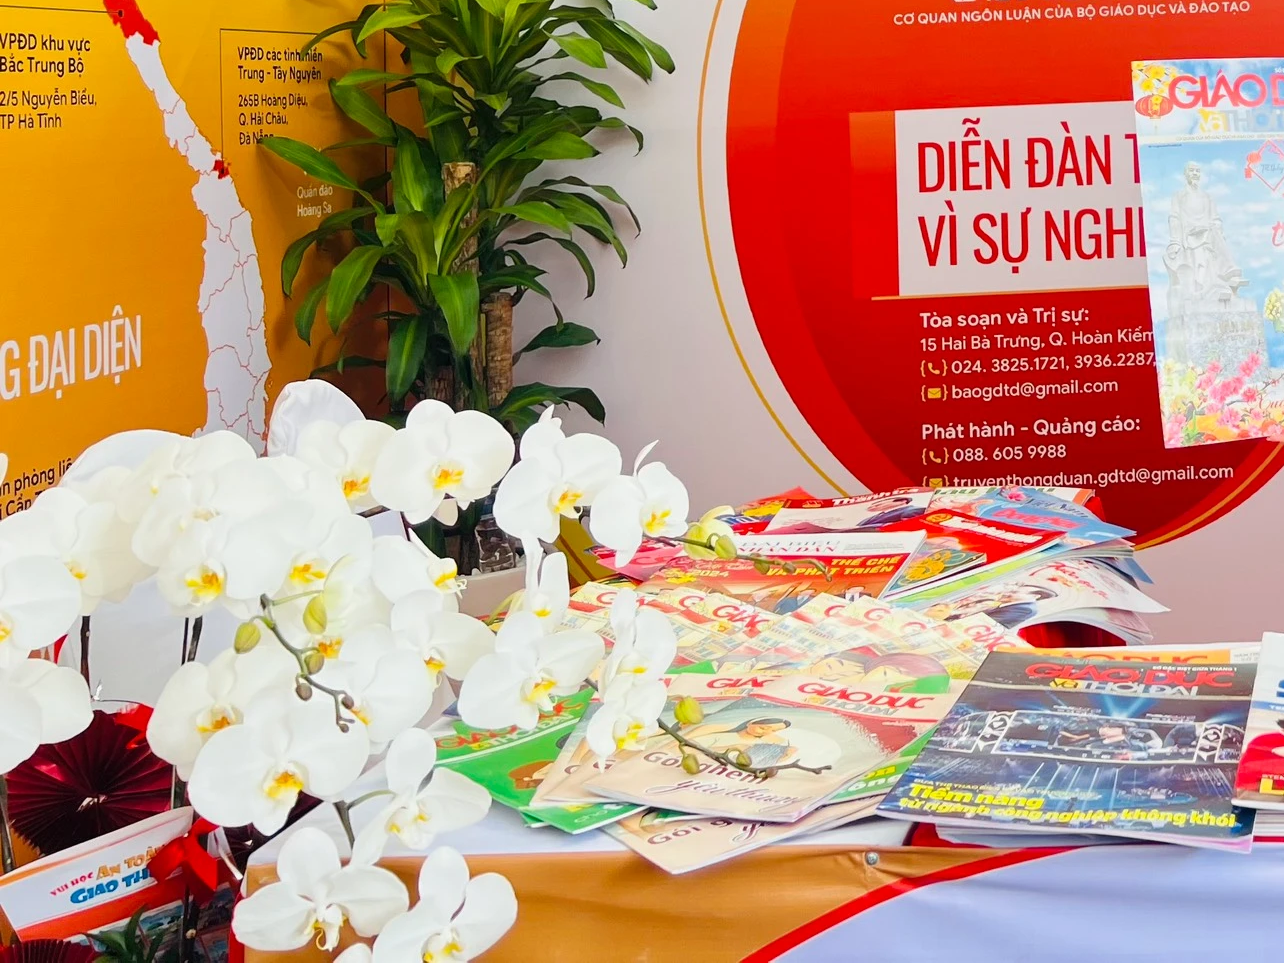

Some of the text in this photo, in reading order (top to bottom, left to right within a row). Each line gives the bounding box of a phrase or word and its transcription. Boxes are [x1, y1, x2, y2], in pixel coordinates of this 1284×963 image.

[893, 0, 1250, 26] CƠ QUAN NGÔN LUẬN CỦA BỘ GIÁO DỤC VÀ ĐÀO TẠO
[0, 33, 90, 55] VPĐD khu vực
[0, 53, 84, 77] Bắc Trung Bộ
[238, 65, 264, 83] Trung
[273, 66, 287, 83] Tây
[290, 67, 322, 83] Nguyên
[22, 88, 67, 109] Nguyễn
[71, 88, 97, 106] Biểu,
[1168, 69, 1267, 109] GIÁO
[239, 93, 308, 109] 265B Hoàng Diệu,
[0, 113, 61, 129] TP Hà Tĩnh
[239, 111, 288, 125] Q. Hải Châu,
[917, 117, 1011, 193] DIỄN
[1025, 121, 1109, 189] ĐÀN
[918, 199, 957, 267] VÌ
[974, 210, 1032, 274] SỰ
[920, 307, 1089, 330] Tòa soạn và Trị sự:
[920, 338, 937, 351] 15
[941, 337, 967, 351] Hai
[971, 335, 990, 350] Bà
[994, 335, 1045, 351] Trưng,
[1049, 332, 1067, 346] Q.
[1072, 329, 1113, 345] Hoàn
[28, 328, 76, 399] ĐẠI
[84, 305, 142, 385] DIỆN
[951, 352, 1157, 374] 024. 3825.1721, 3936.2287,
[952, 379, 1118, 400] baogdtd@gmail.com
[921, 423, 965, 440] Phát
[969, 421, 1015, 438] hành
[1033, 417, 1096, 438] Quảng
[1102, 416, 1140, 432] cáo:
[953, 445, 1066, 462] 088. 605 9988
